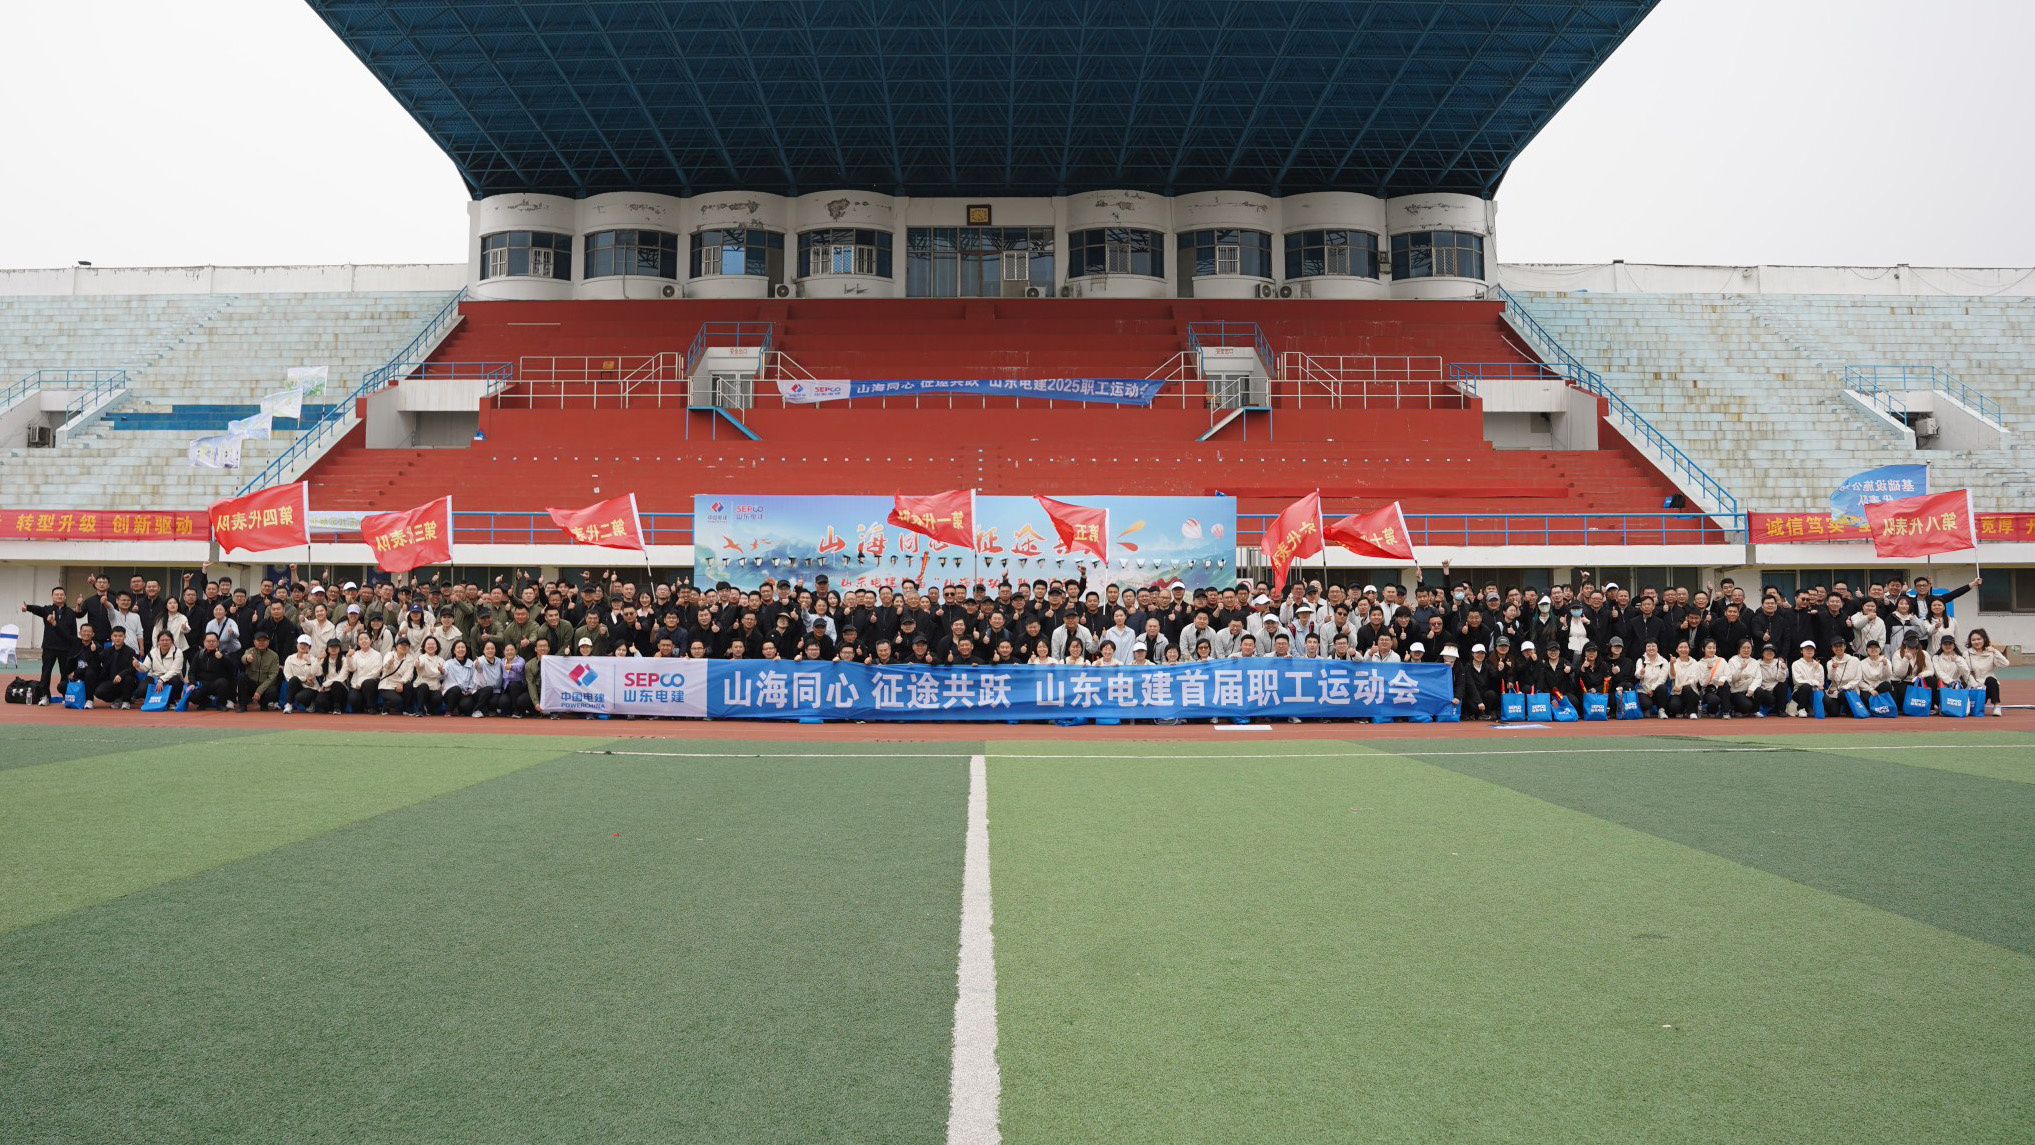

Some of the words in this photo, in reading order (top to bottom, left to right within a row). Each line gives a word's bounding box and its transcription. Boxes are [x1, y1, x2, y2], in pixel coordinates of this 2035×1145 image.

[857, 381, 915, 394] 山海同心
[736, 505, 764, 513] SEPCO
[16, 514, 97, 533] 转型升级
[112, 514, 193, 536] 创新驱动
[1975, 516, 2015, 535] 宽厚
[624, 672, 685, 688] SEPCO
[561, 691, 605, 703] 中国电建
[623, 689, 685, 703] 山东电建
[723, 670, 860, 709] 山海同心
[871, 671, 1012, 710] 征途共跃
[1035, 669, 1420, 708] 山东电建首届职工运动会
